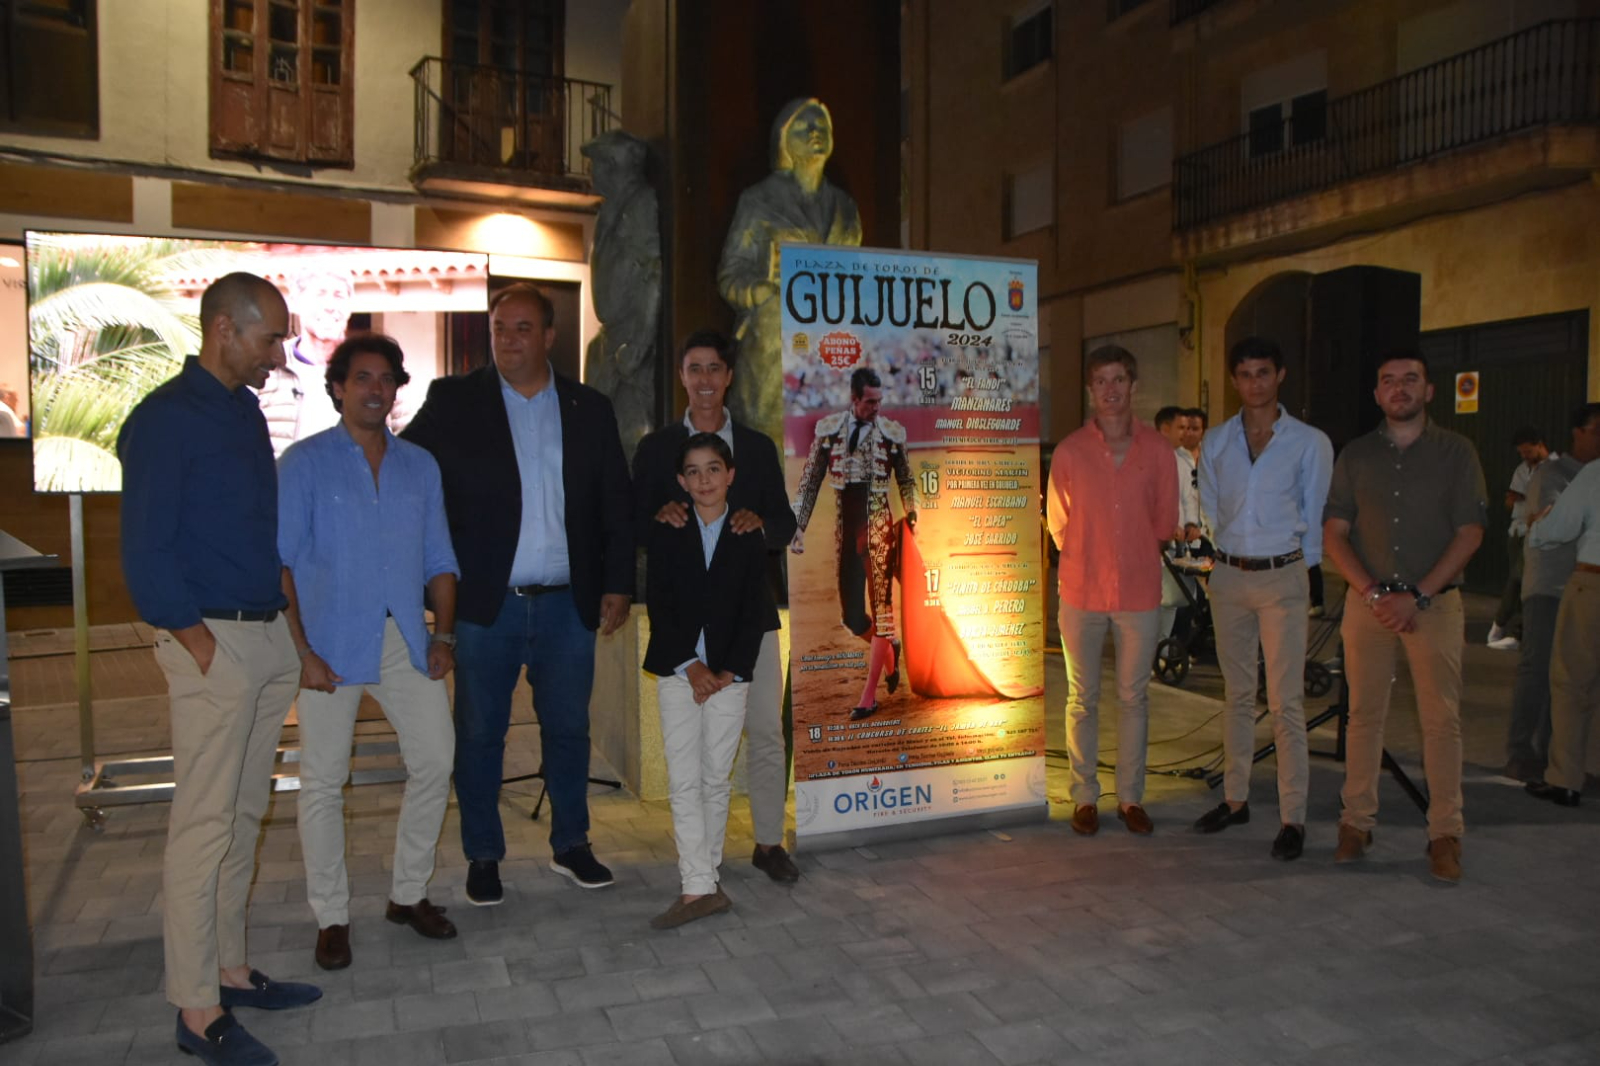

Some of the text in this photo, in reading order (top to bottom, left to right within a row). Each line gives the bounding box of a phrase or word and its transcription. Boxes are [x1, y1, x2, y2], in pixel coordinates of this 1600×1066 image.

[795, 258, 940, 276] PLAZA DE TOROS DE
[785, 271, 996, 331] GUIJUELO
[823, 338, 856, 346] ABONO
[947, 333, 994, 347] 2024
[825, 346, 857, 355] PEÑAS
[831, 355, 851, 365] 25€
[918, 367, 936, 390] 15
[951, 397, 1012, 412] MANZANARES
[935, 418, 964, 430] MANUEL
[920, 470, 938, 495] 16
[950, 496, 983, 509] MANUEL
[987, 496, 1027, 509] ESCRIBANO
[985, 532, 1017, 545] GARRIDO
[924, 568, 939, 592] 17
[982, 581, 991, 594] DE
[994, 599, 1025, 613] PERERA
[808, 727, 821, 740] 18
[857, 730, 894, 739] CONCURSO
